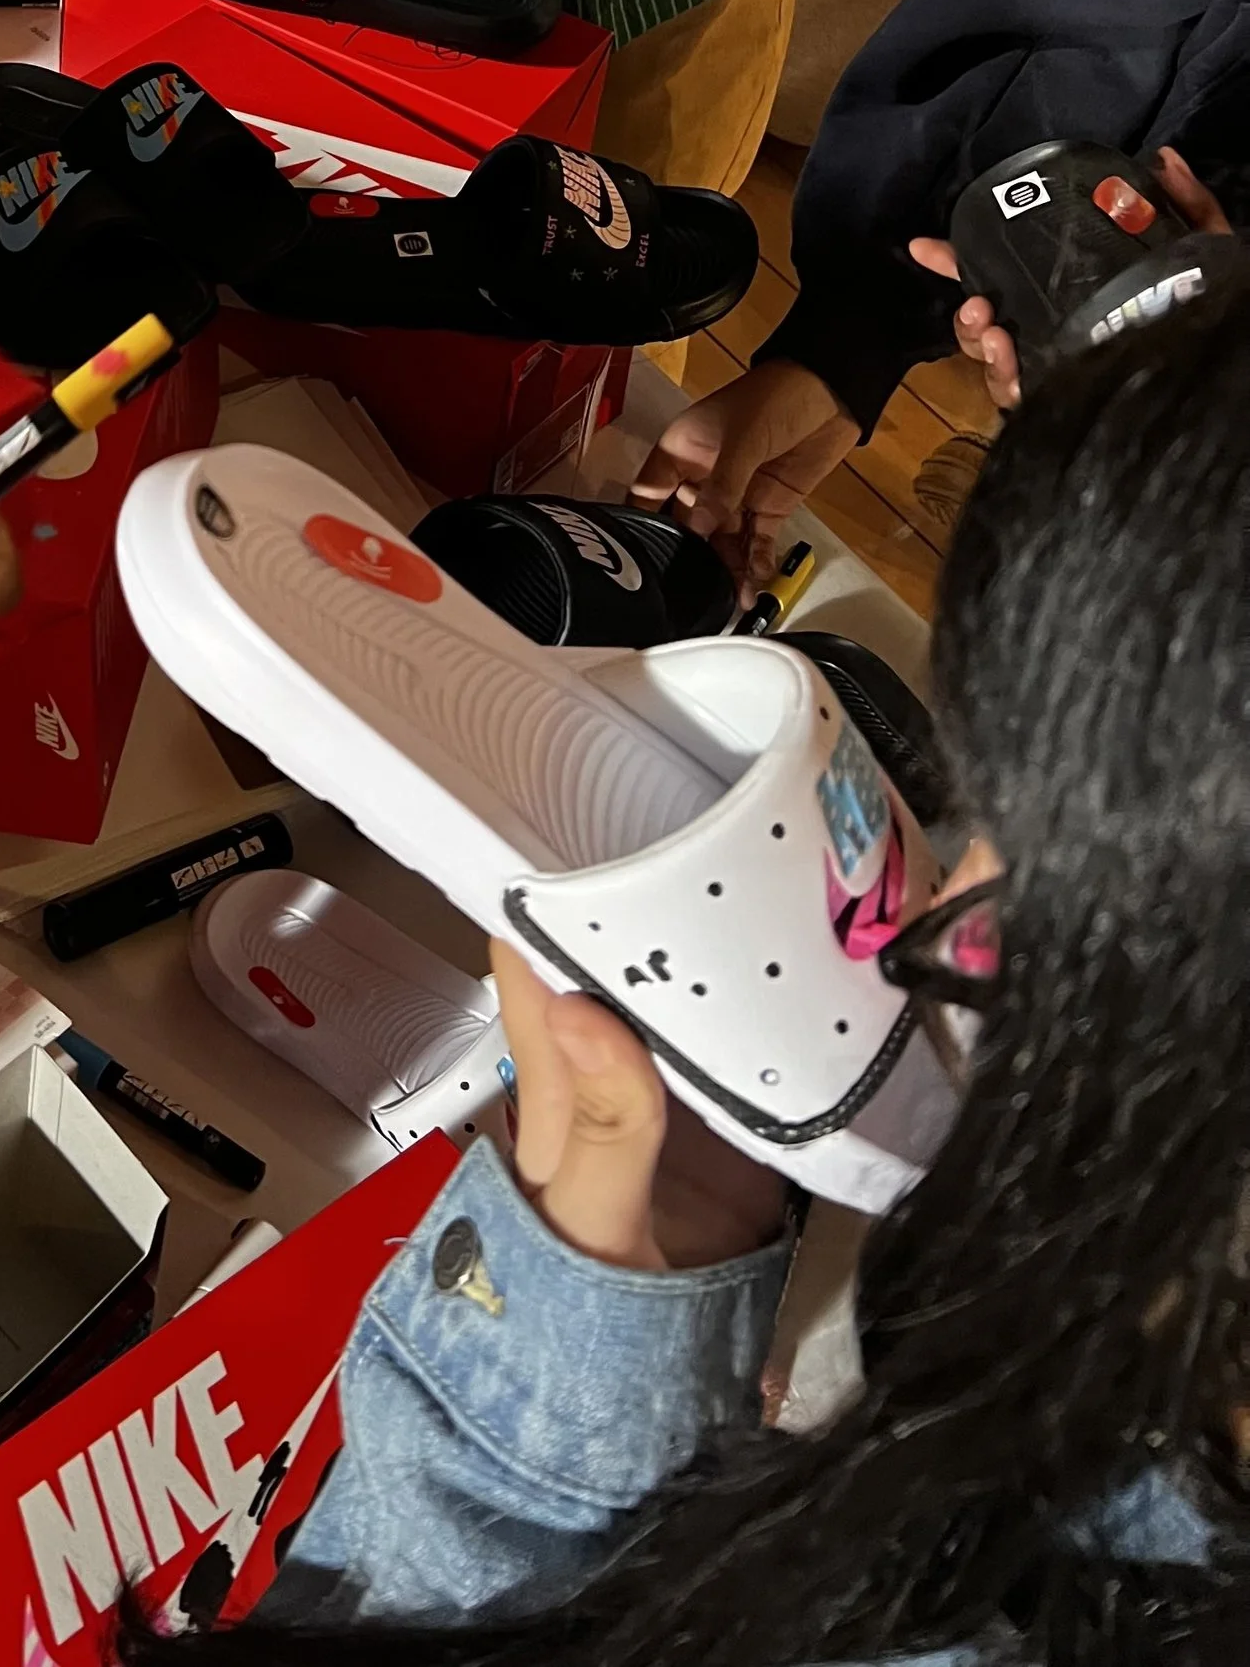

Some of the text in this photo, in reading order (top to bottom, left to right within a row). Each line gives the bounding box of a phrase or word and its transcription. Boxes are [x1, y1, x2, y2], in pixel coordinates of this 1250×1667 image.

[120, 72, 188, 132] NIKE
[541, 215, 559, 256] TRUST
[635, 232, 651, 268] EXCEL
[34, 701, 60, 750] NIKE
[17, 1350, 267, 1647] NIKE
